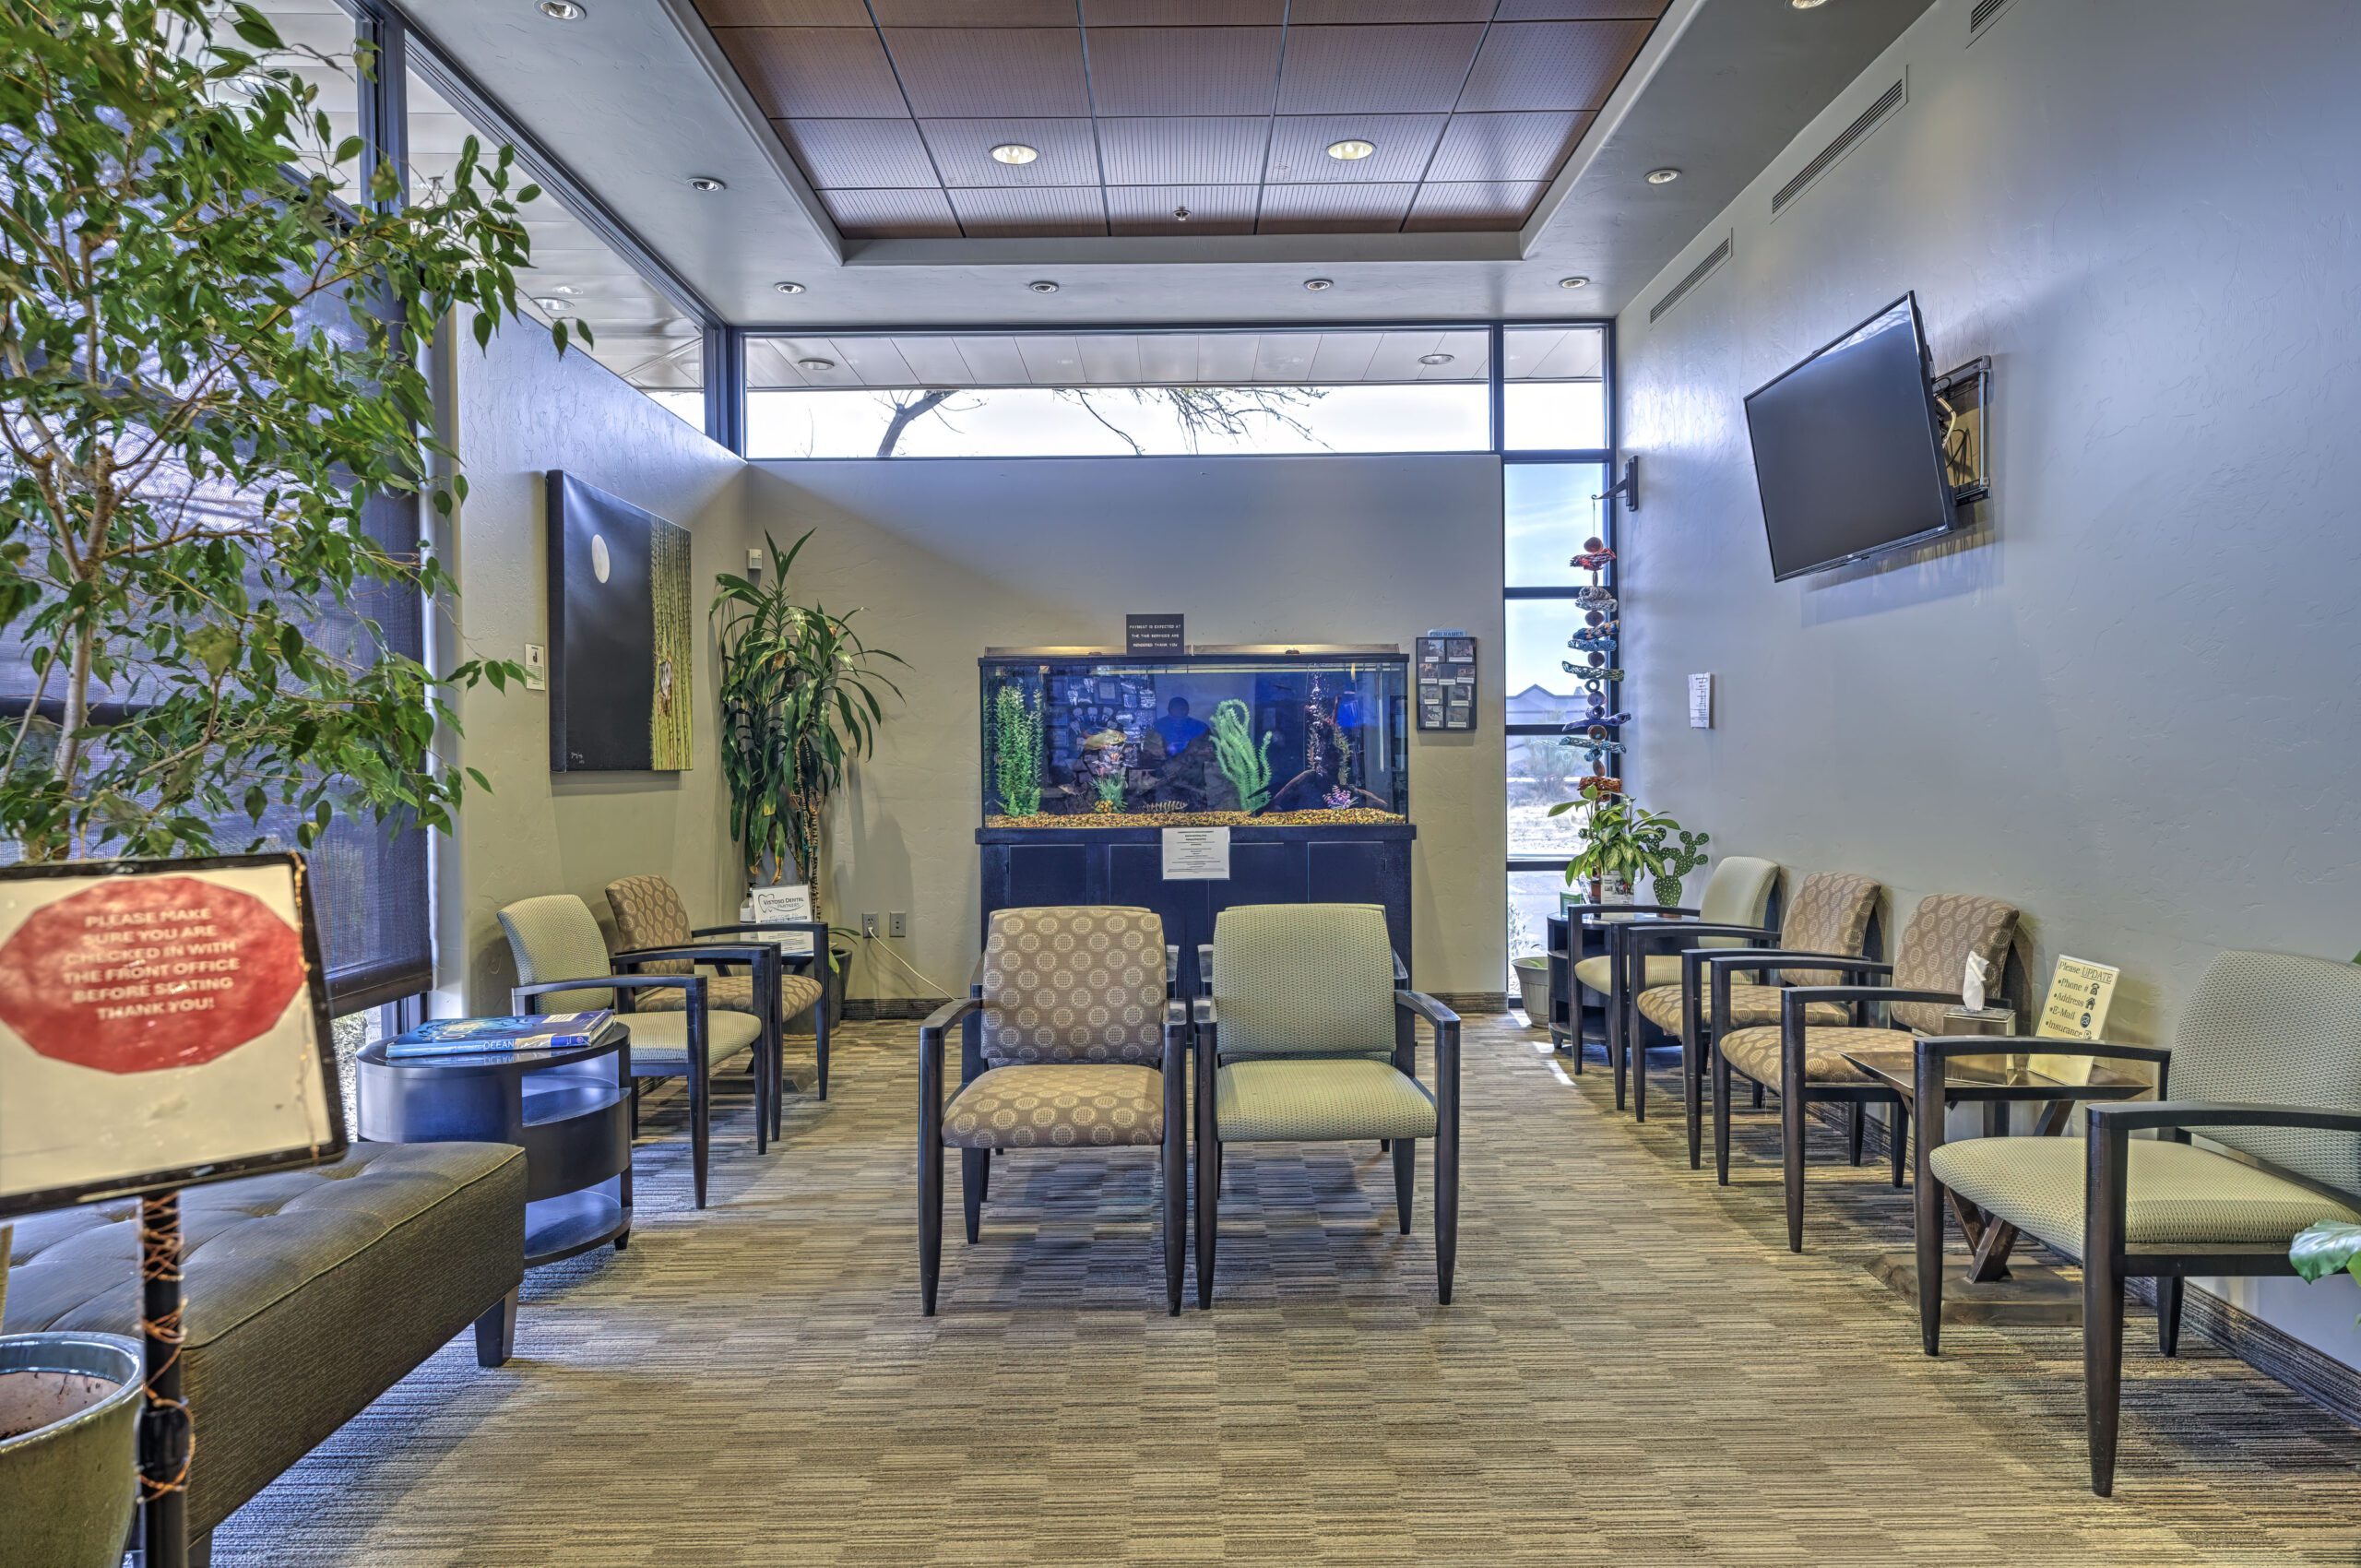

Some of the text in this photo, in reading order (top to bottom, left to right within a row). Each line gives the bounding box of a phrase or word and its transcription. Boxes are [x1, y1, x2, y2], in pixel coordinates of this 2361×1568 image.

[85, 908, 212, 928] PLEASE MAKE
[82, 924, 218, 946] SURE YOU ARE
[65, 941, 236, 965] CHECKED IN WITH
[63, 957, 241, 985] THE FRONT OFFICE
[2058, 959, 2114, 983] Please UPDATE
[72, 977, 233, 1004] BEFORE SEATING
[97, 997, 215, 1020] THANK YOU!
[483, 1039, 515, 1050] OCEAN
